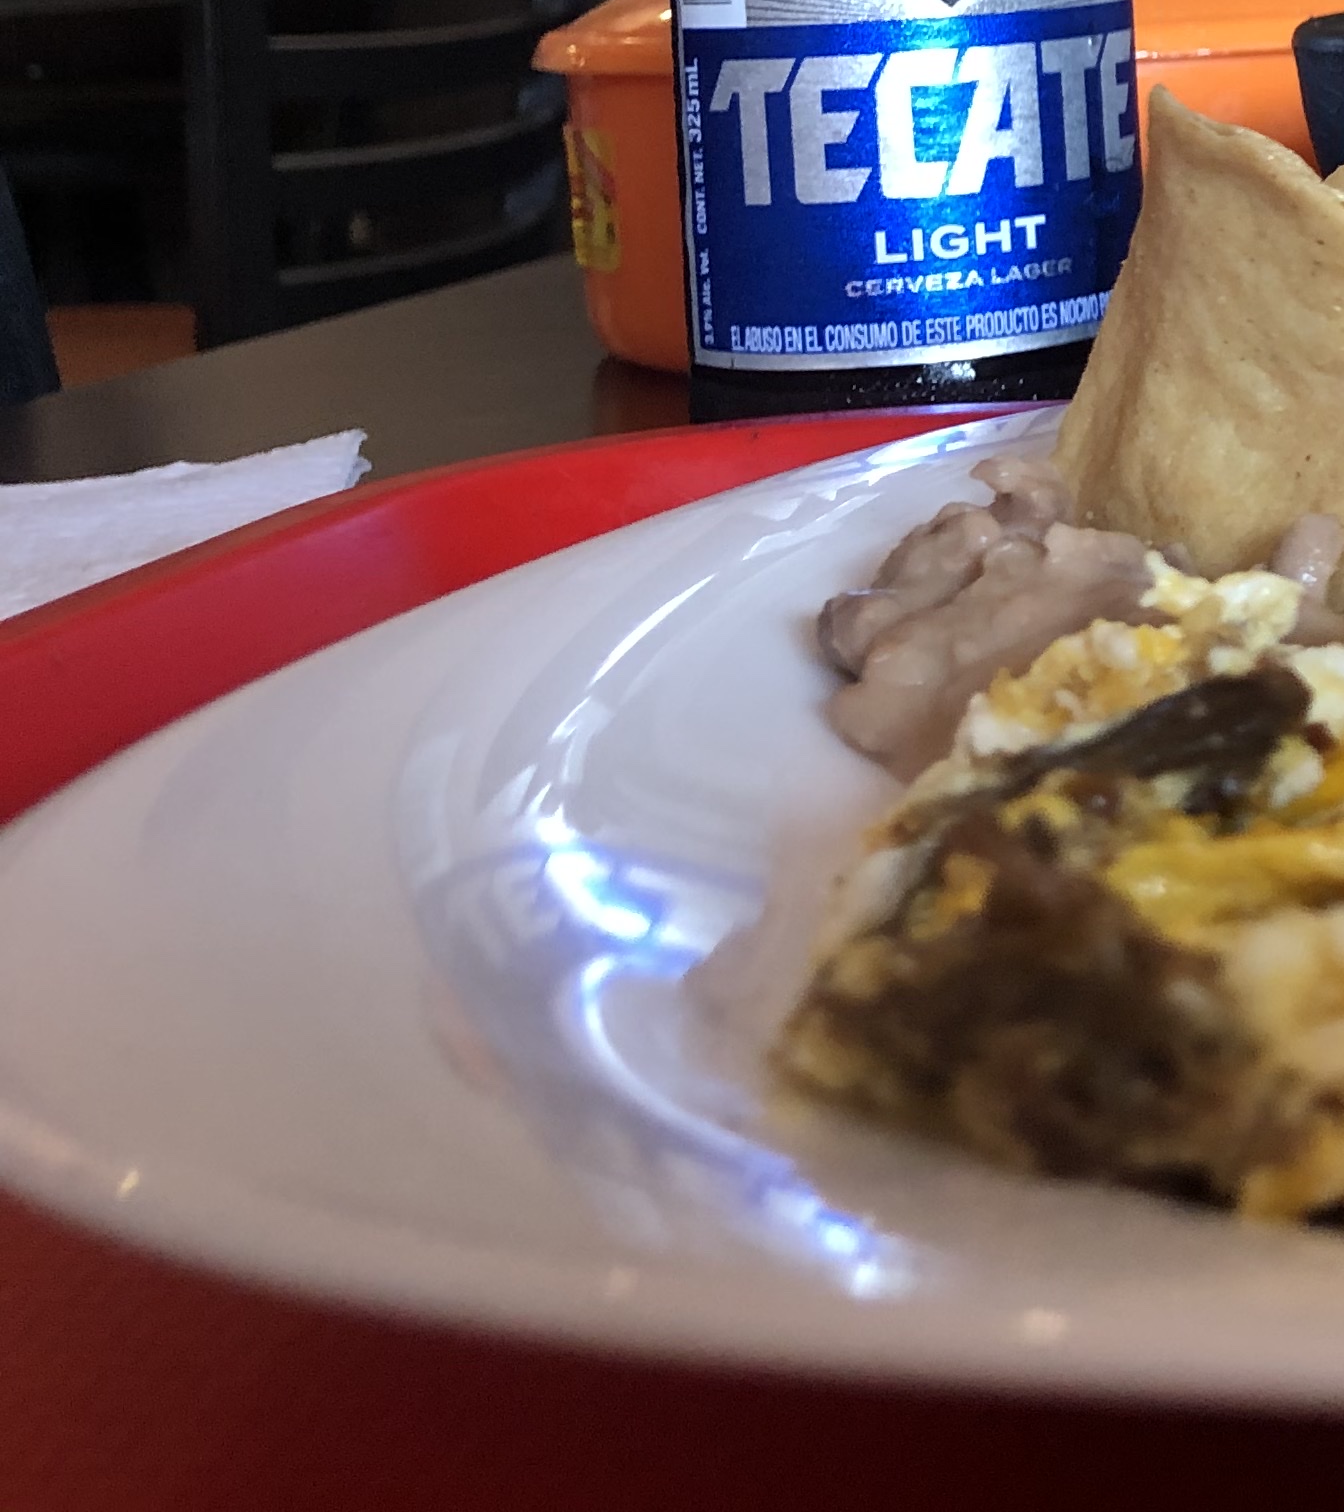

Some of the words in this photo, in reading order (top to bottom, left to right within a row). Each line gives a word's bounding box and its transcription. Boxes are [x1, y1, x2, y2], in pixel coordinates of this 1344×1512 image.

[709, 28, 1136, 207] TECATE
[873, 213, 1047, 265] LIGHT
[844, 269, 985, 298] CERVEZA
[990, 256, 1074, 285] LAGER
[730, 324, 745, 352] EL
[745, 325, 782, 353] ABUSO
[784, 325, 803, 353] EN
[804, 324, 823, 352] EL
[824, 319, 898, 352] CONSUMO
[901, 319, 922, 347] DE
[925, 316, 963, 345] ESTE
[966, 303, 1039, 340] PRODUCTO
[1041, 300, 1059, 330] ES
[1060, 292, 1099, 326] NOCIVO
